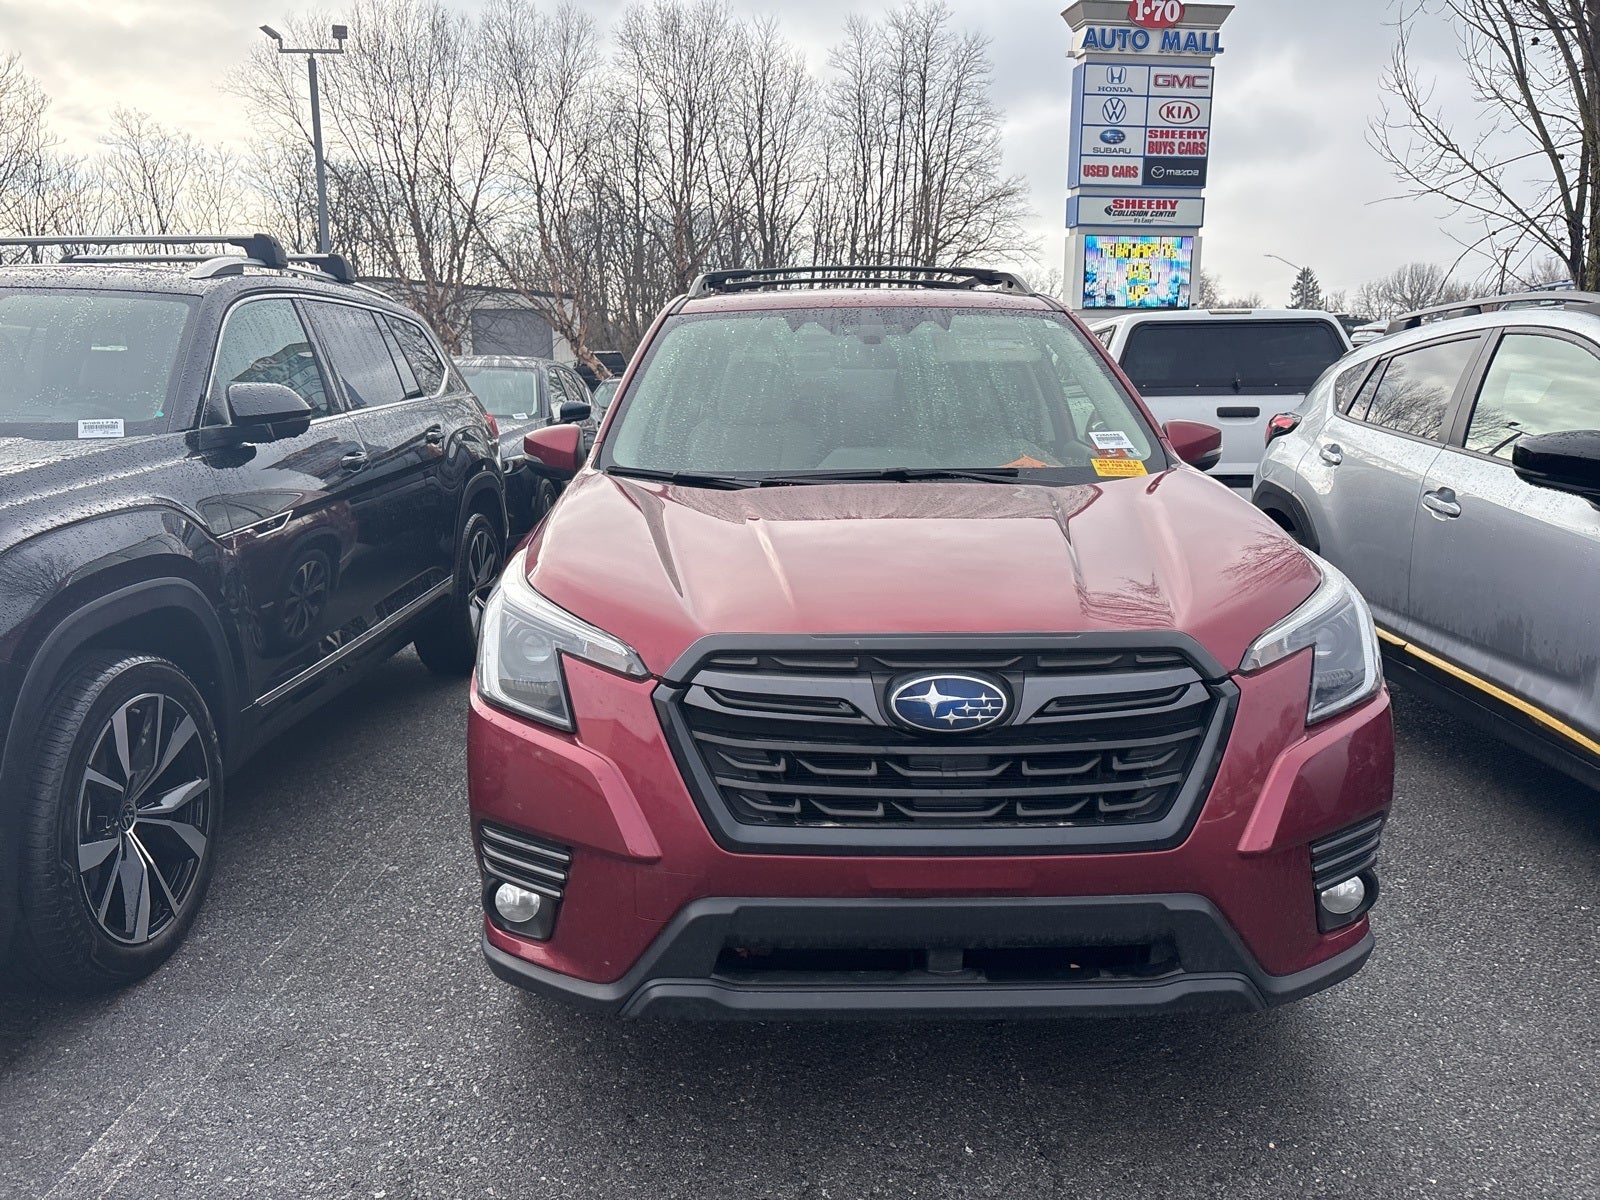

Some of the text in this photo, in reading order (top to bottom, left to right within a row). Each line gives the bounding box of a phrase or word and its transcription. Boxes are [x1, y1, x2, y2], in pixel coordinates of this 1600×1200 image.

[1082, 28, 1224, 53] AUTO MALL
[1154, 74, 1209, 89] GMC
[1166, 106, 1193, 119] KIA
[1148, 130, 1207, 139] SHEEHY
[1147, 141, 1206, 155] BUYS CARS
[1083, 165, 1138, 178] USED CARS
[1112, 199, 1178, 209] SHEEHY
